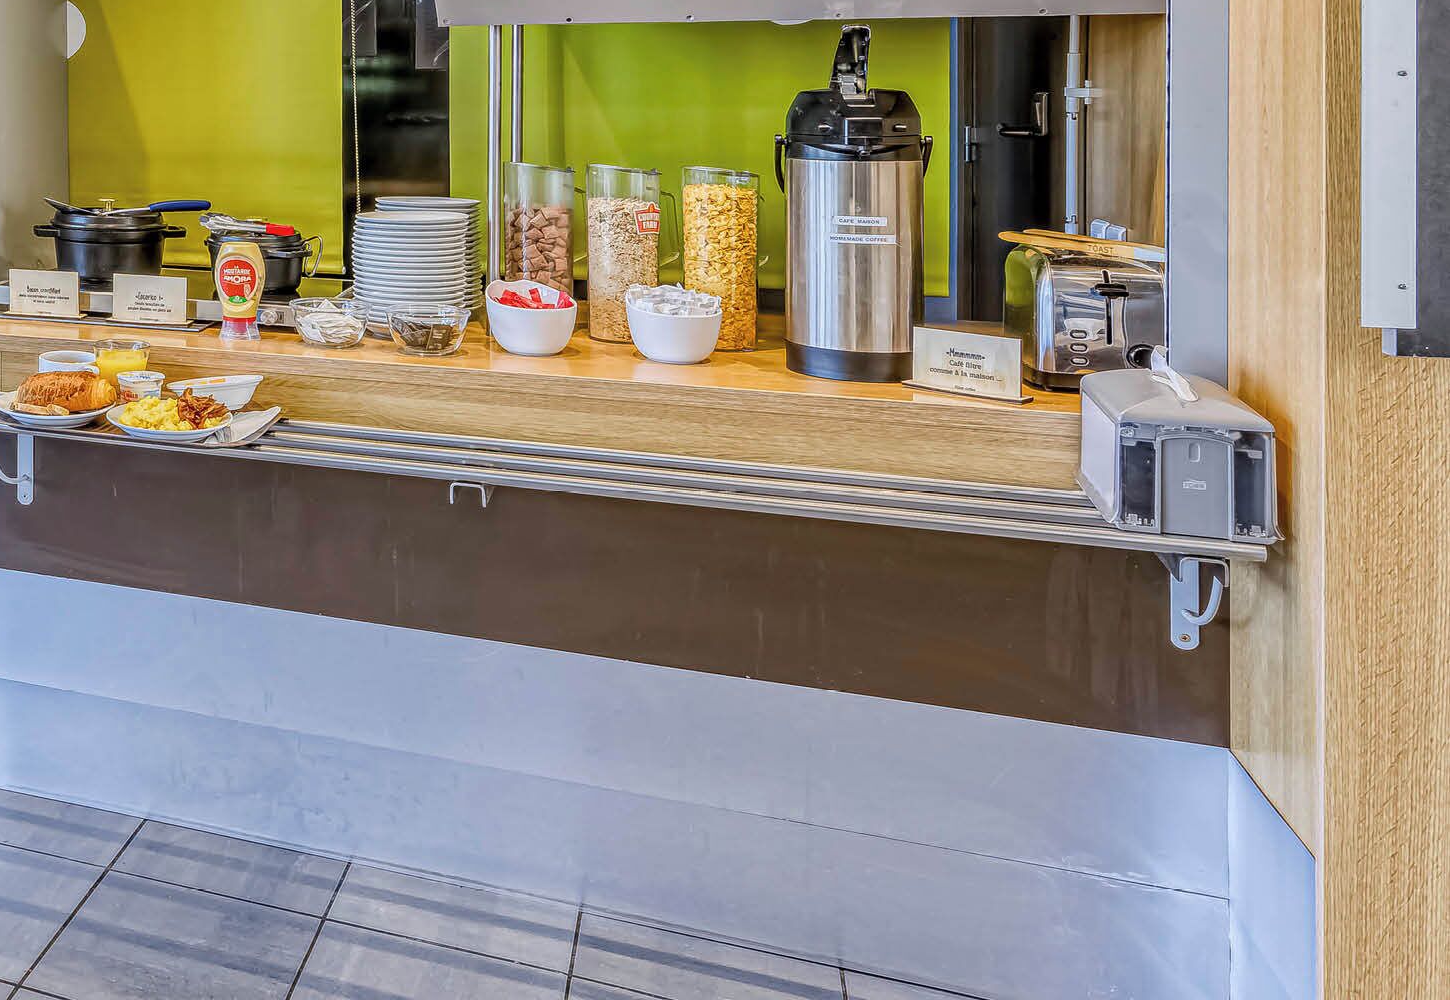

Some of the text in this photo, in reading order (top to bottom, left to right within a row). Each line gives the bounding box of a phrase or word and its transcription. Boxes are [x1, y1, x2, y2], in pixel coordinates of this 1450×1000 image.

[1087, 244, 1114, 254] TOAST
[223, 275, 252, 283] AMORA
[949, 359, 982, 370] Café filtre
[929, 367, 995, 381] comme à la maison
